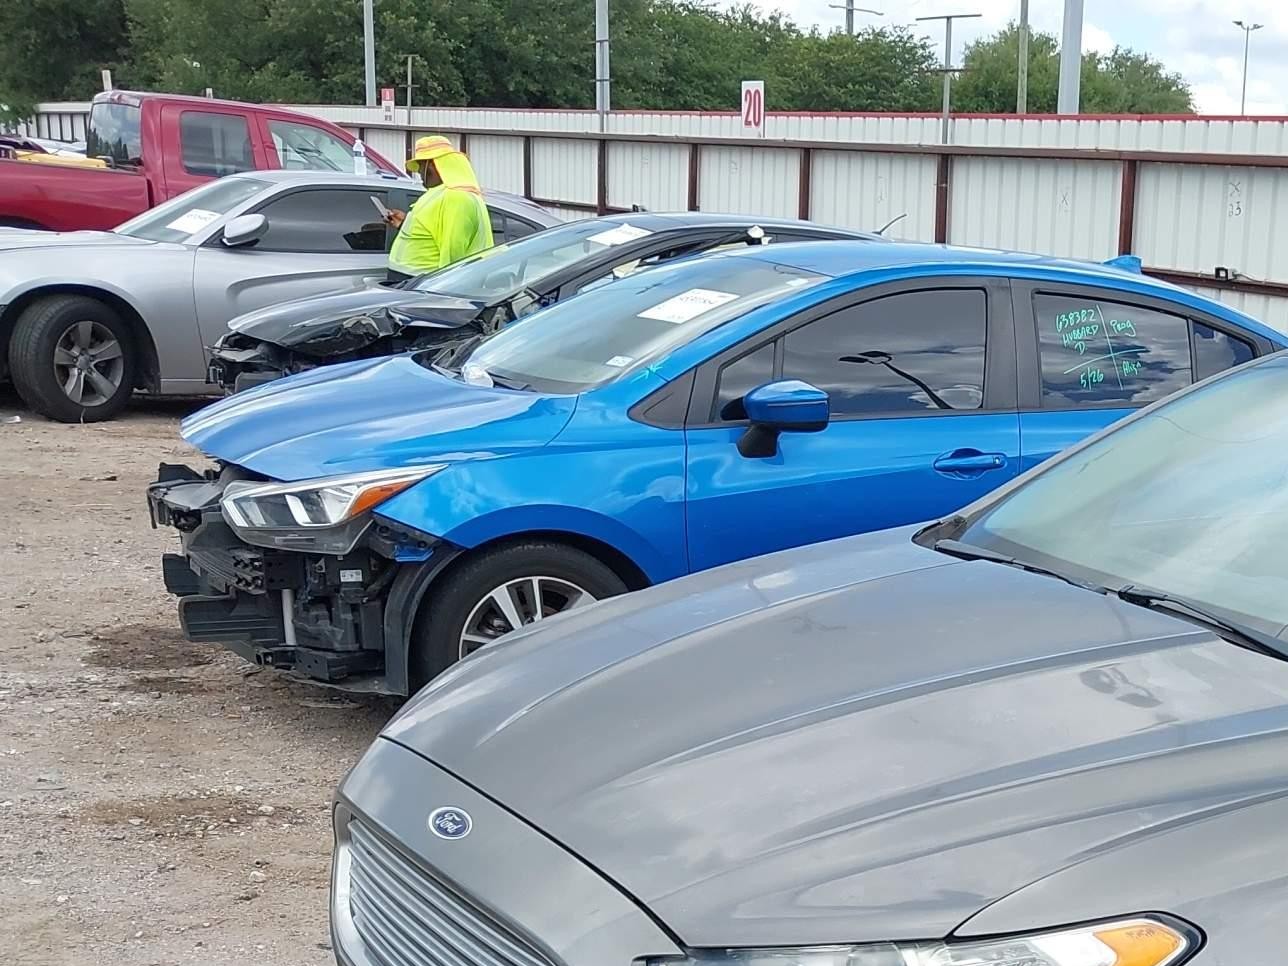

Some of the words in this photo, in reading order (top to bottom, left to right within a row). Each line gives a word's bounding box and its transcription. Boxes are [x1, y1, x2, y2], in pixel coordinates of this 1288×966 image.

[744, 89, 761, 127] 20
[1080, 367, 1104, 390] 5/26
[436, 812, 463, 834] Ford
